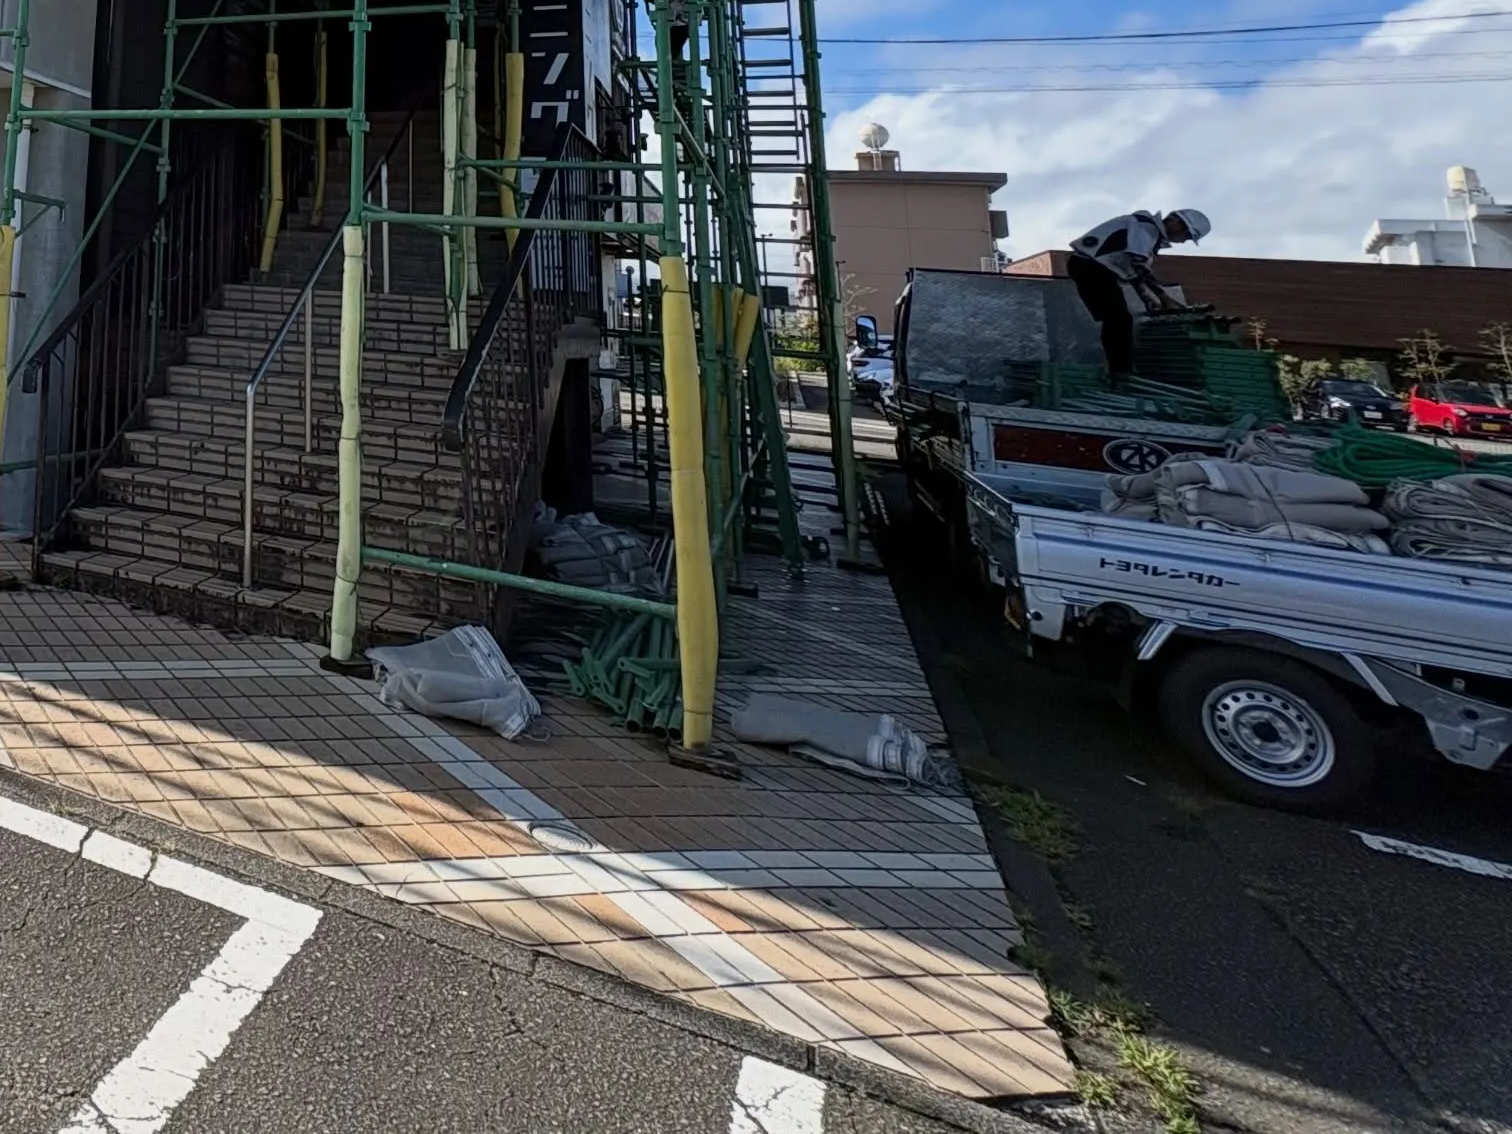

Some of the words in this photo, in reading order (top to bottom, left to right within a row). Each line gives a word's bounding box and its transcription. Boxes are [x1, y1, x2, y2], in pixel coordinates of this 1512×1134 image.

[1099, 557, 1240, 586] トヨタレンタカー
